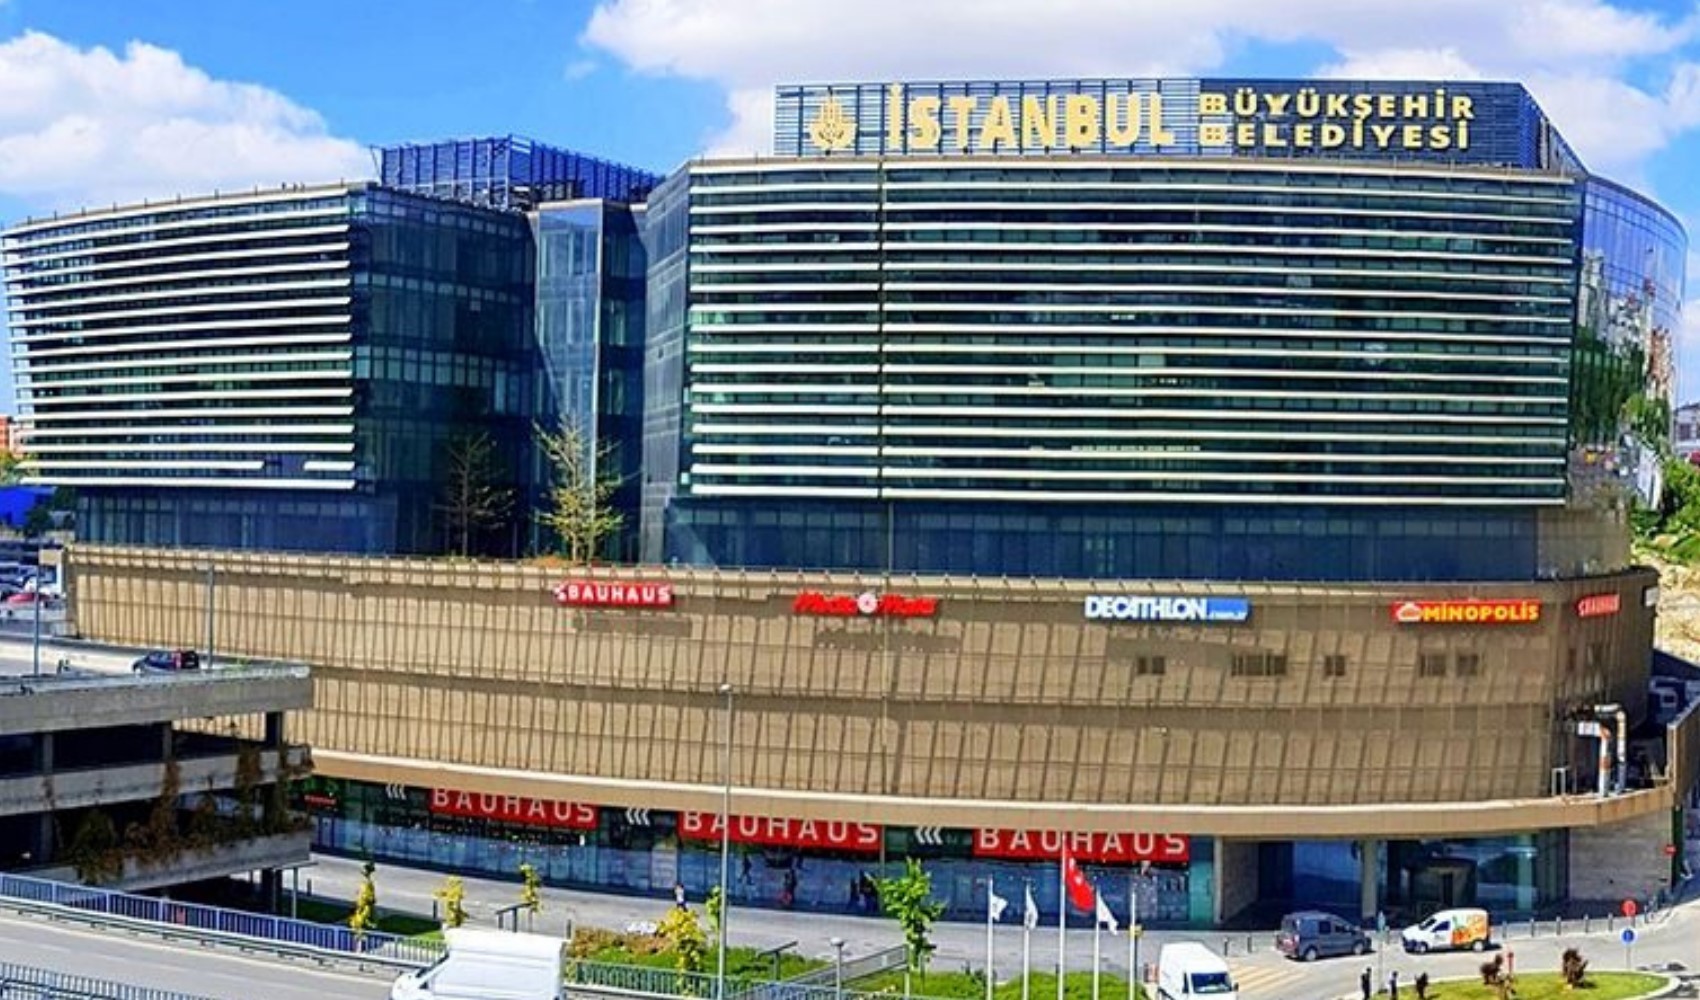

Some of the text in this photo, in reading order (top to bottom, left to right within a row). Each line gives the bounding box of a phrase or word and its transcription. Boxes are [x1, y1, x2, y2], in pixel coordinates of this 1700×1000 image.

[888, 83, 1175, 149] İSTANBUL
[1200, 88, 1473, 120] BÜYÜKŞEHİR
[1200, 118, 1468, 149] BELEDİYESİ
[568, 584, 671, 604] BAUHAUS
[1085, 596, 1208, 620] DECATHLON
[1422, 601, 1540, 622] MİNOPOLİS
[432, 787, 595, 823] BAUHAUS
[683, 810, 878, 844] BAUHAUS
[979, 828, 1186, 855] BAUHAUS
